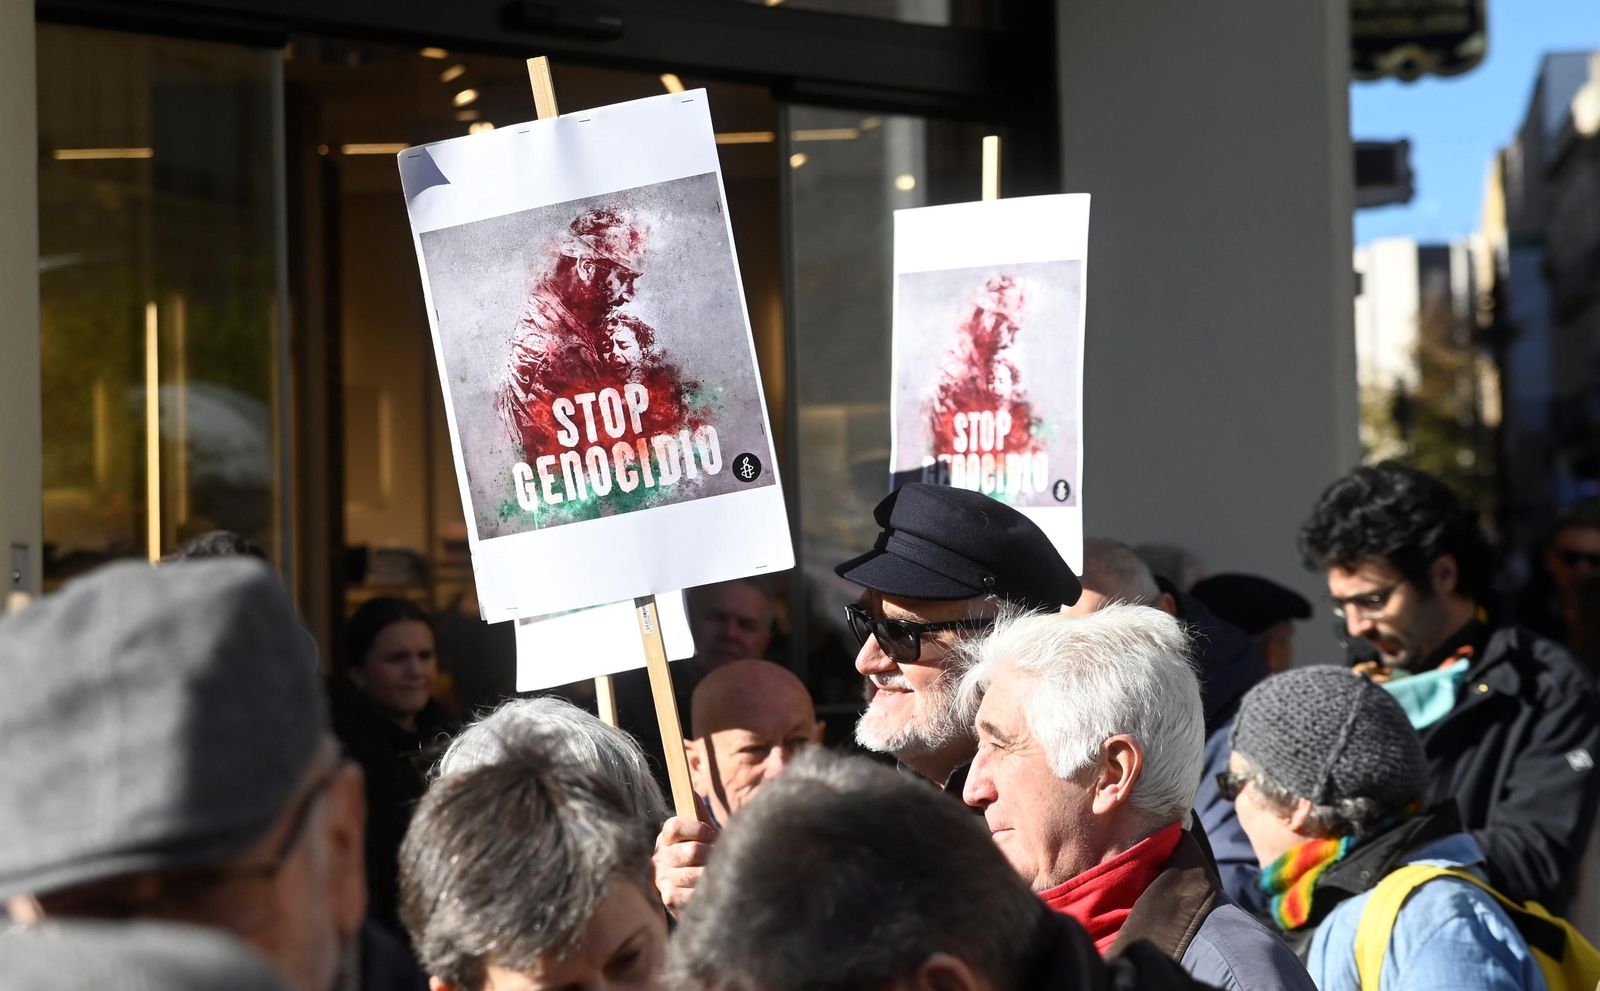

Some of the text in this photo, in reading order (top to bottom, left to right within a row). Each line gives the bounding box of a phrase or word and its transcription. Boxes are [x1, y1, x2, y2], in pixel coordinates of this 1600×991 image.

[552, 383, 649, 447] STOP
[953, 410, 1012, 453] STOP
[512, 424, 723, 511] GENOCIDIO
